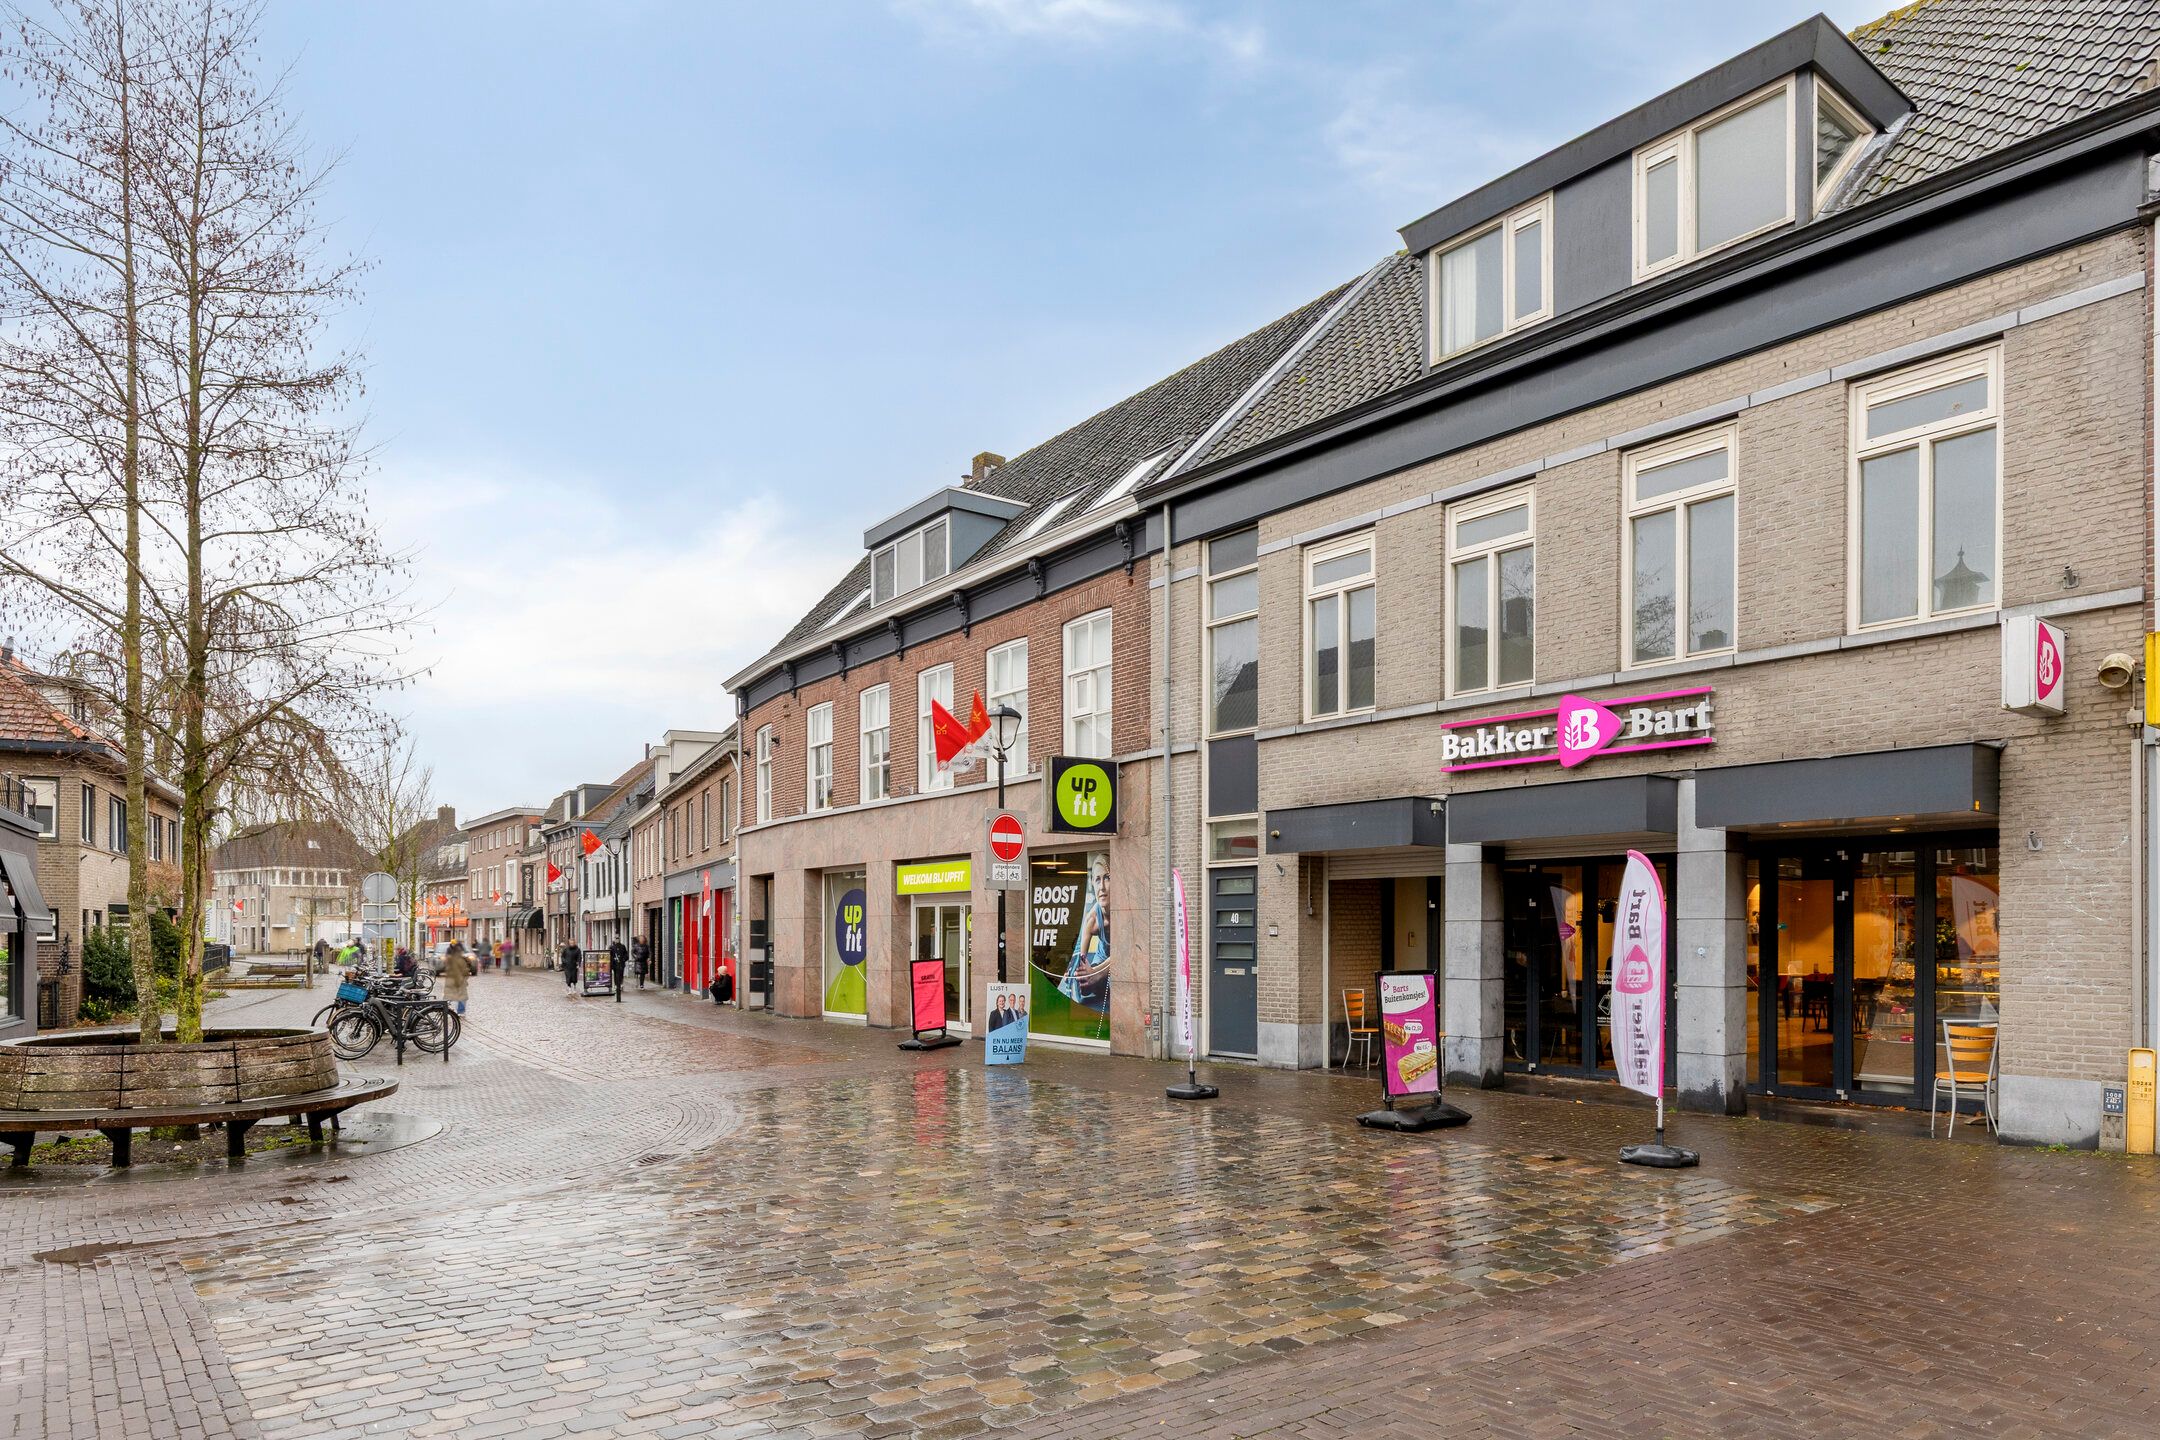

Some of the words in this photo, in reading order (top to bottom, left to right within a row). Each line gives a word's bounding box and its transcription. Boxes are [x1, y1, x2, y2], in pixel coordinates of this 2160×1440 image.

[2040, 640, 2055, 686] B
[1441, 725, 1550, 761] Bakker
[1629, 701, 1712, 738] Bart
[1071, 776, 1098, 800] up
[1073, 793, 1097, 817] fit
[903, 873, 933, 885] WELKOM
[933, 871, 944, 884] BIJ
[944, 870, 966, 883] UPFIT
[1033, 885, 1079, 904] BOOST
[844, 905, 863, 933] up
[1034, 907, 1070, 925] YOUR
[1230, 912, 1239, 924] 40
[845, 925, 862, 952] fit
[1033, 929, 1058, 946] LIFE
[1392, 985, 1409, 993] Barts
